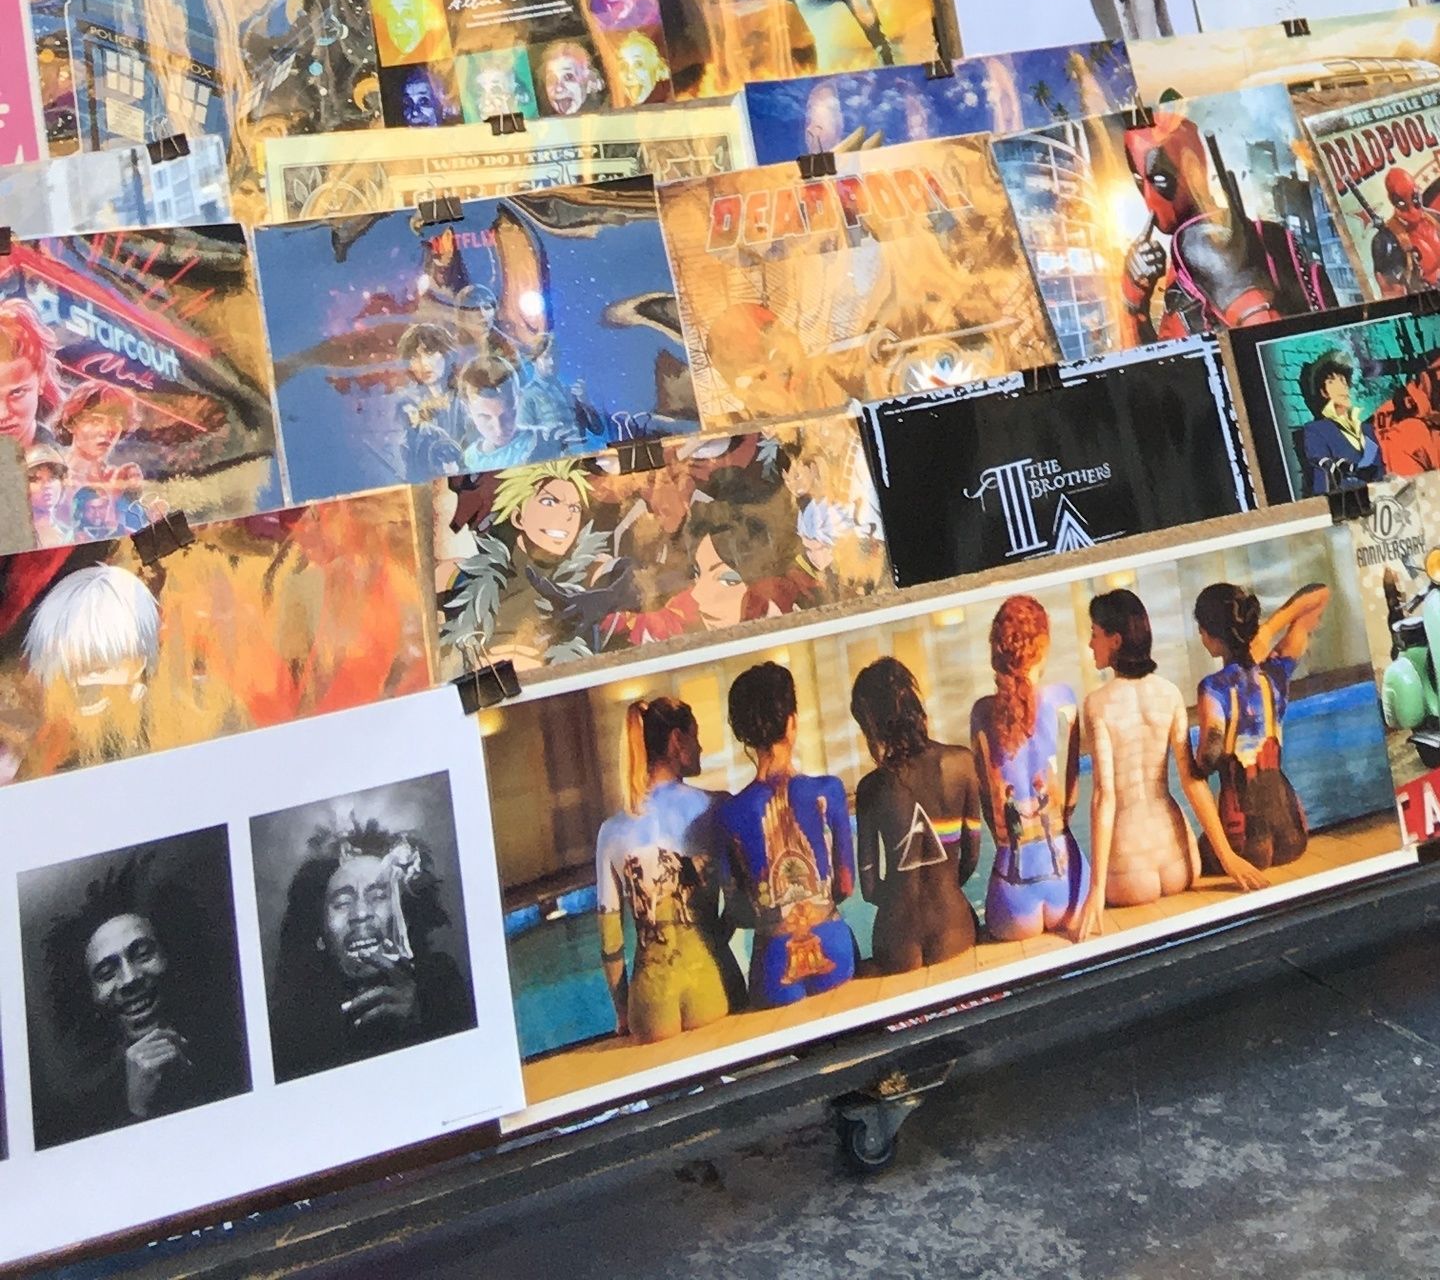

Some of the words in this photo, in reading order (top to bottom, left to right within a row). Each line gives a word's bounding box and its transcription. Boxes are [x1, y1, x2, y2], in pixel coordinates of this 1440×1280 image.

[89, 25, 136, 48] POLICE
[1372, 97, 1422, 119] BATTLE
[1421, 93, 1439, 107] OF
[431, 156, 480, 171] WHO
[483, 153, 511, 167] DO
[512, 152, 521, 165] I
[525, 144, 599, 165] TRUST?
[1320, 114, 1440, 187] DEADPOOL
[705, 165, 974, 253] DEADPOOL
[66, 301, 181, 380] starcourt
[1024, 458, 1062, 479] THE
[1026, 461, 1113, 500] BROTHERS
[1356, 532, 1426, 568] ANNIVERSARY
